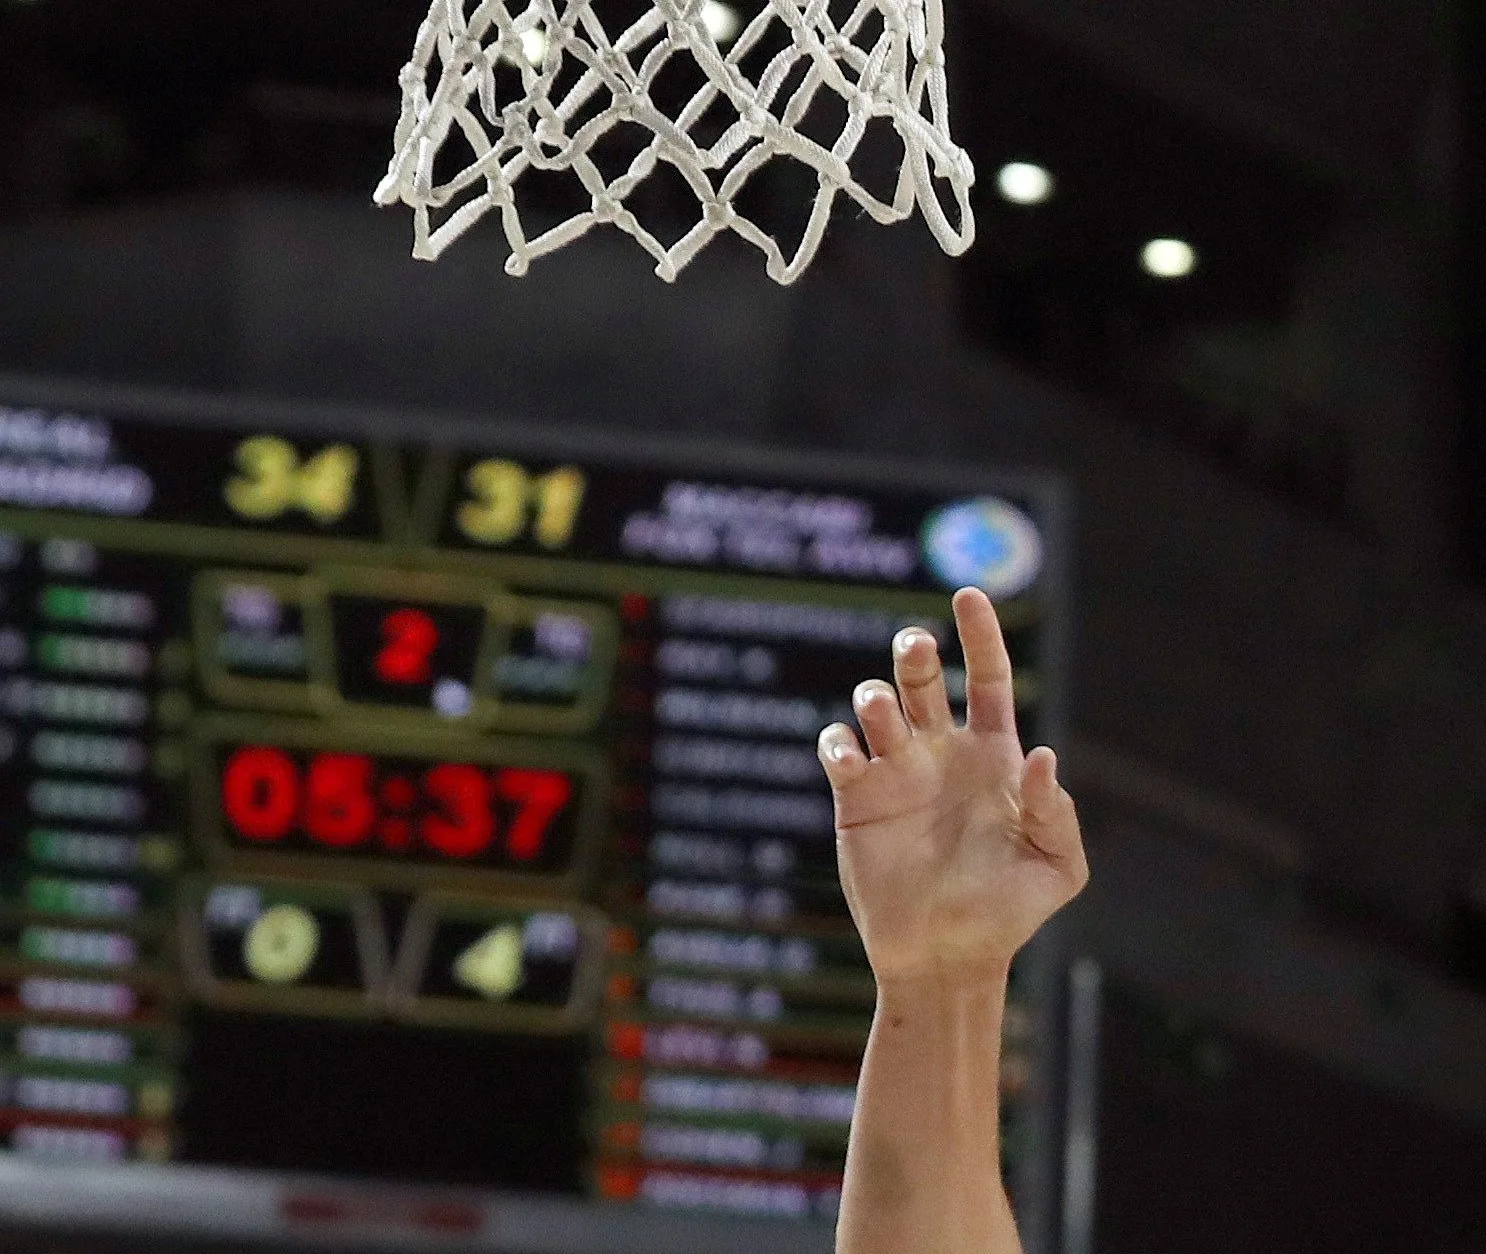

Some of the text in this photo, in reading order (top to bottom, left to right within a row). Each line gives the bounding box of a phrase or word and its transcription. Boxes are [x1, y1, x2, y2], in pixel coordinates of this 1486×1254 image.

[223, 436, 358, 522] 34
[456, 458, 586, 549] 31
[376, 608, 438, 685] 2
[245, 904, 320, 982] 0
